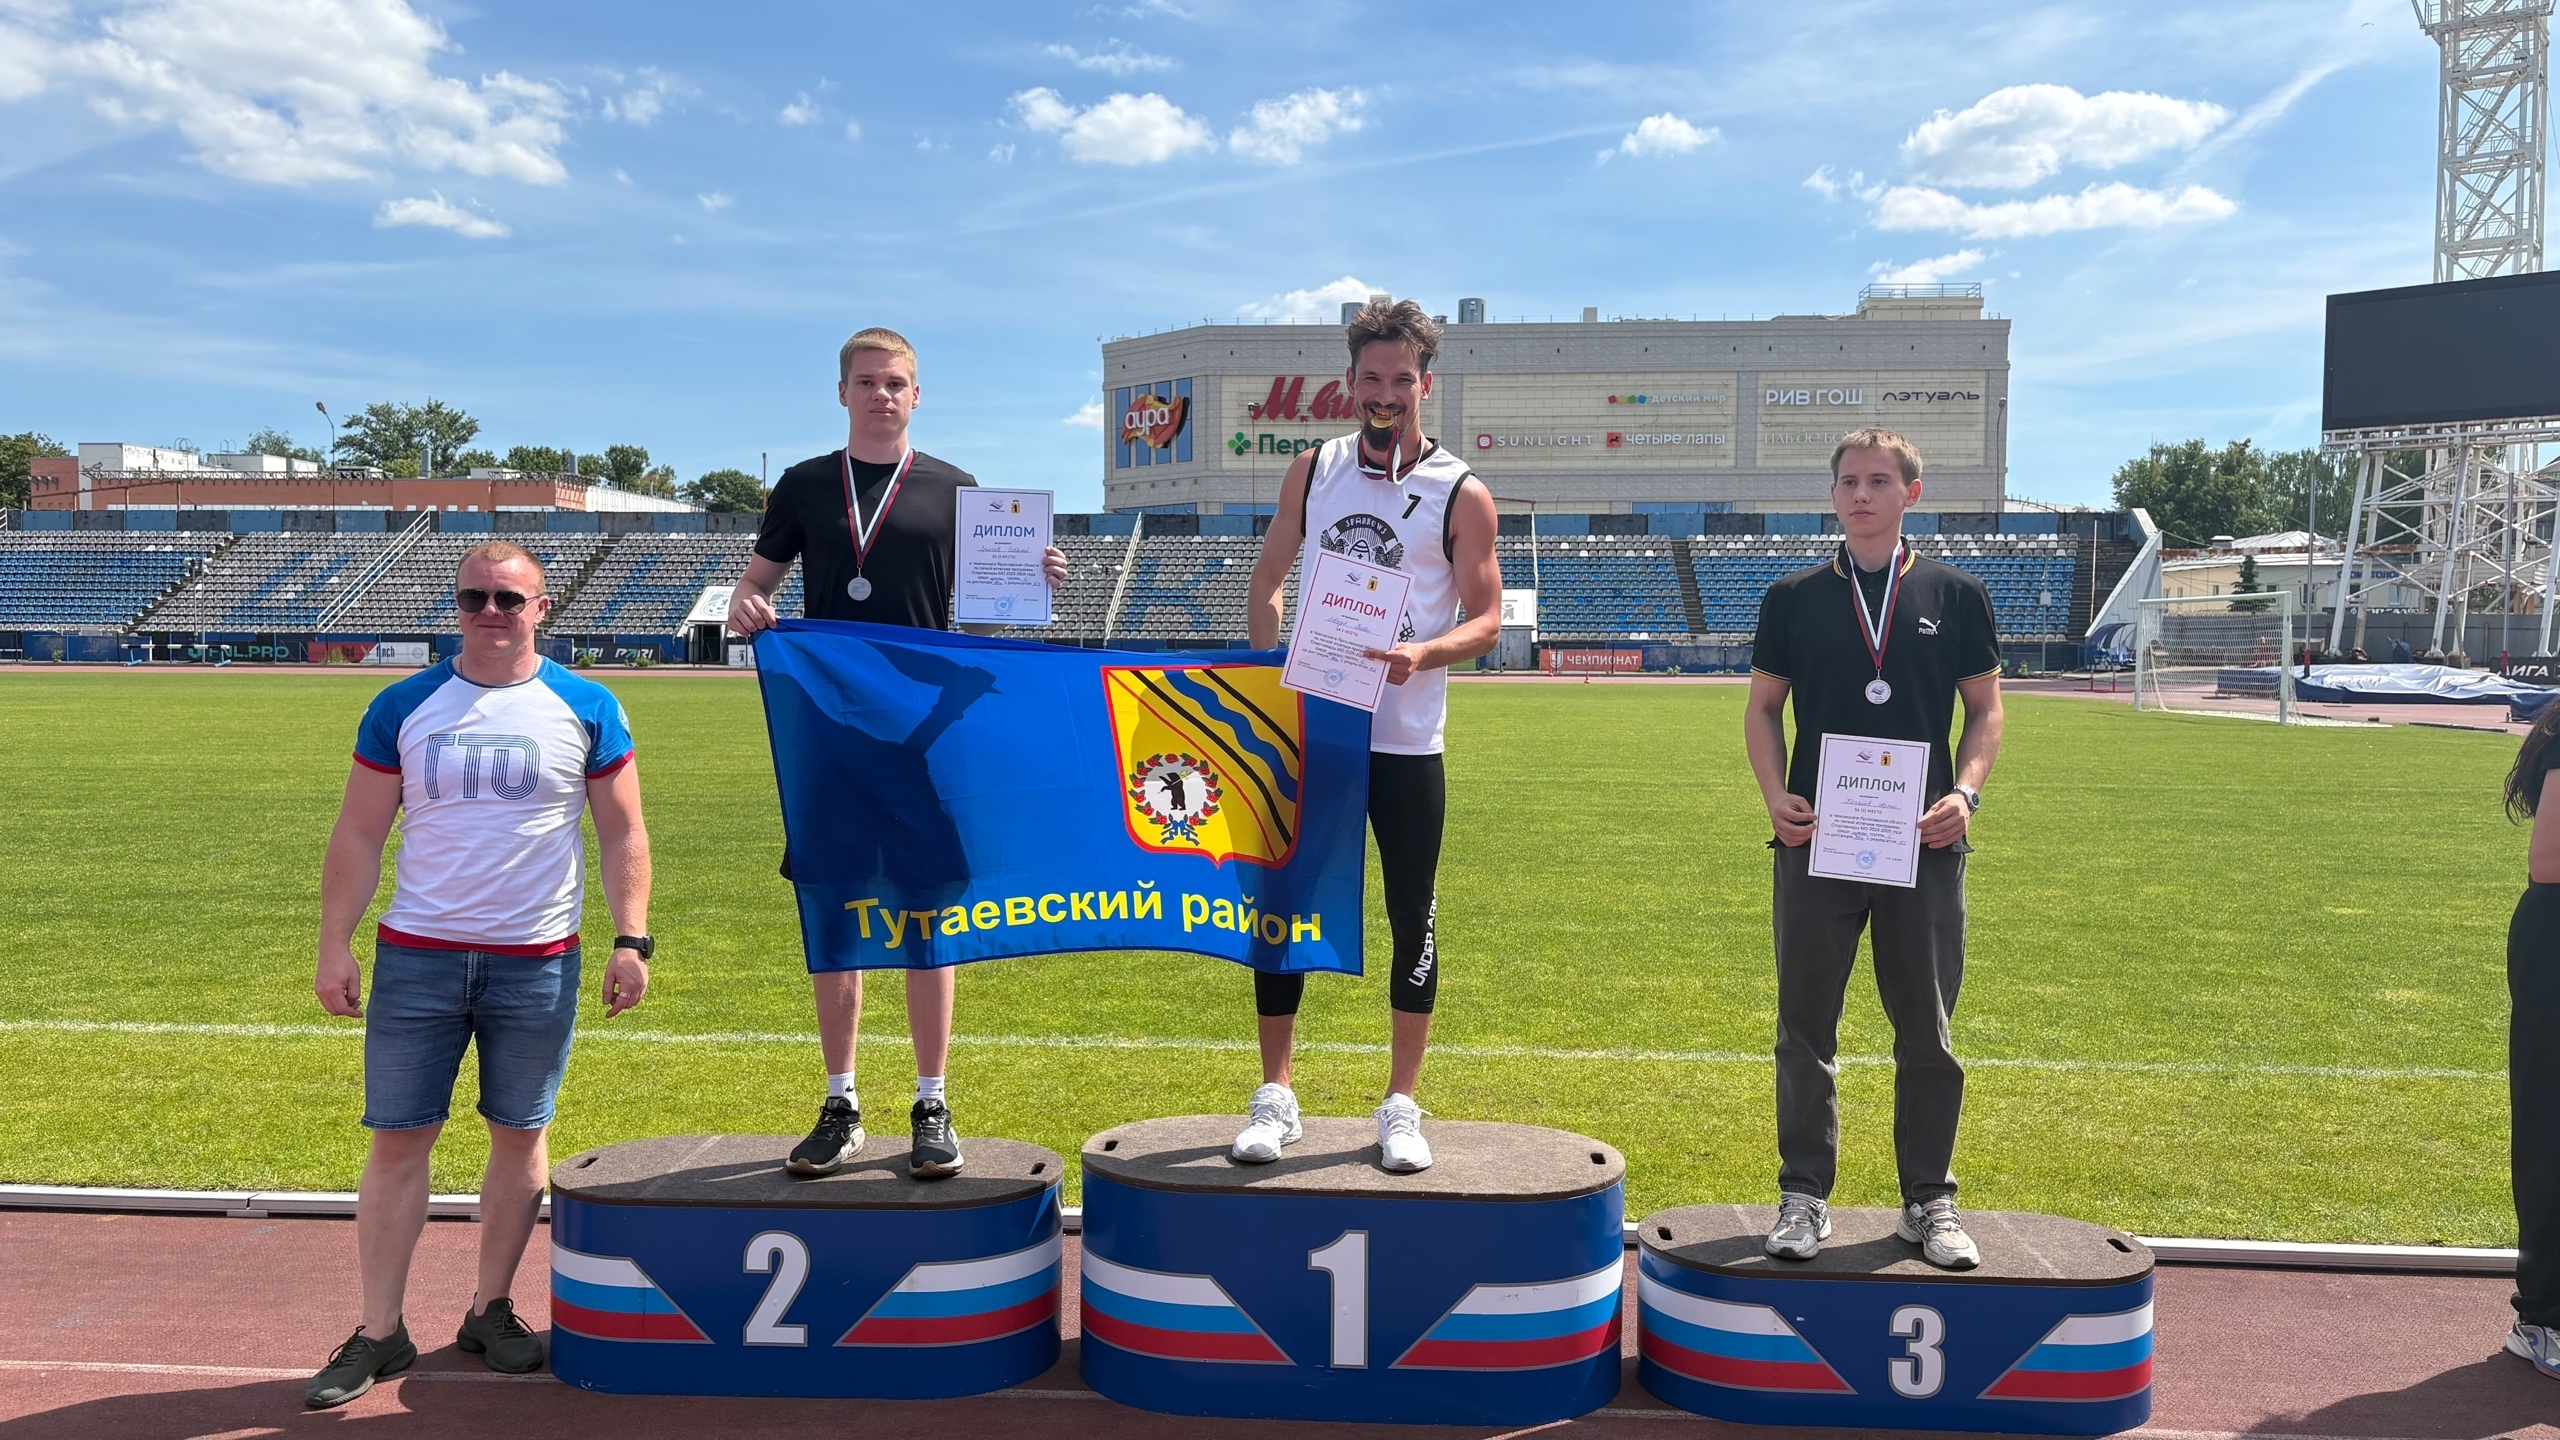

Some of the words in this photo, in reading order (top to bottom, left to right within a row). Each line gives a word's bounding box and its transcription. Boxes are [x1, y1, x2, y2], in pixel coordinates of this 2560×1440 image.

[1652, 393, 1700, 404] детский
[1703, 394, 1726, 405] мир
[1766, 390, 1810, 406] РИВ
[1816, 388, 1863, 405] ГОШ
[1124, 408, 1170, 436] аура
[1497, 436, 1594, 446] SUNLIGHT
[1626, 434, 1682, 448] четыре
[1686, 434, 1726, 446] лапы
[1402, 493, 1422, 520] 7
[973, 525, 1035, 538] ДИПЛОМ
[1345, 518, 1388, 534] SPARROWS
[1322, 592, 1387, 620] ДИПЛОМ
[376, 646, 395, 658] fnch
[615, 648, 654, 658] PARI
[1567, 655, 1638, 665] ЧЕМПИОНАТ
[425, 734, 541, 800] ГТО
[1836, 775, 1906, 793] ДИПЛОМ
[844, 879, 1162, 948] Тутаевский
[1183, 893, 1322, 945] район
[1408, 932, 1434, 987] UNDER
[743, 1230, 810, 1347] 2
[1308, 1230, 1368, 1369] 1
[1888, 1304, 1946, 1399] 3
